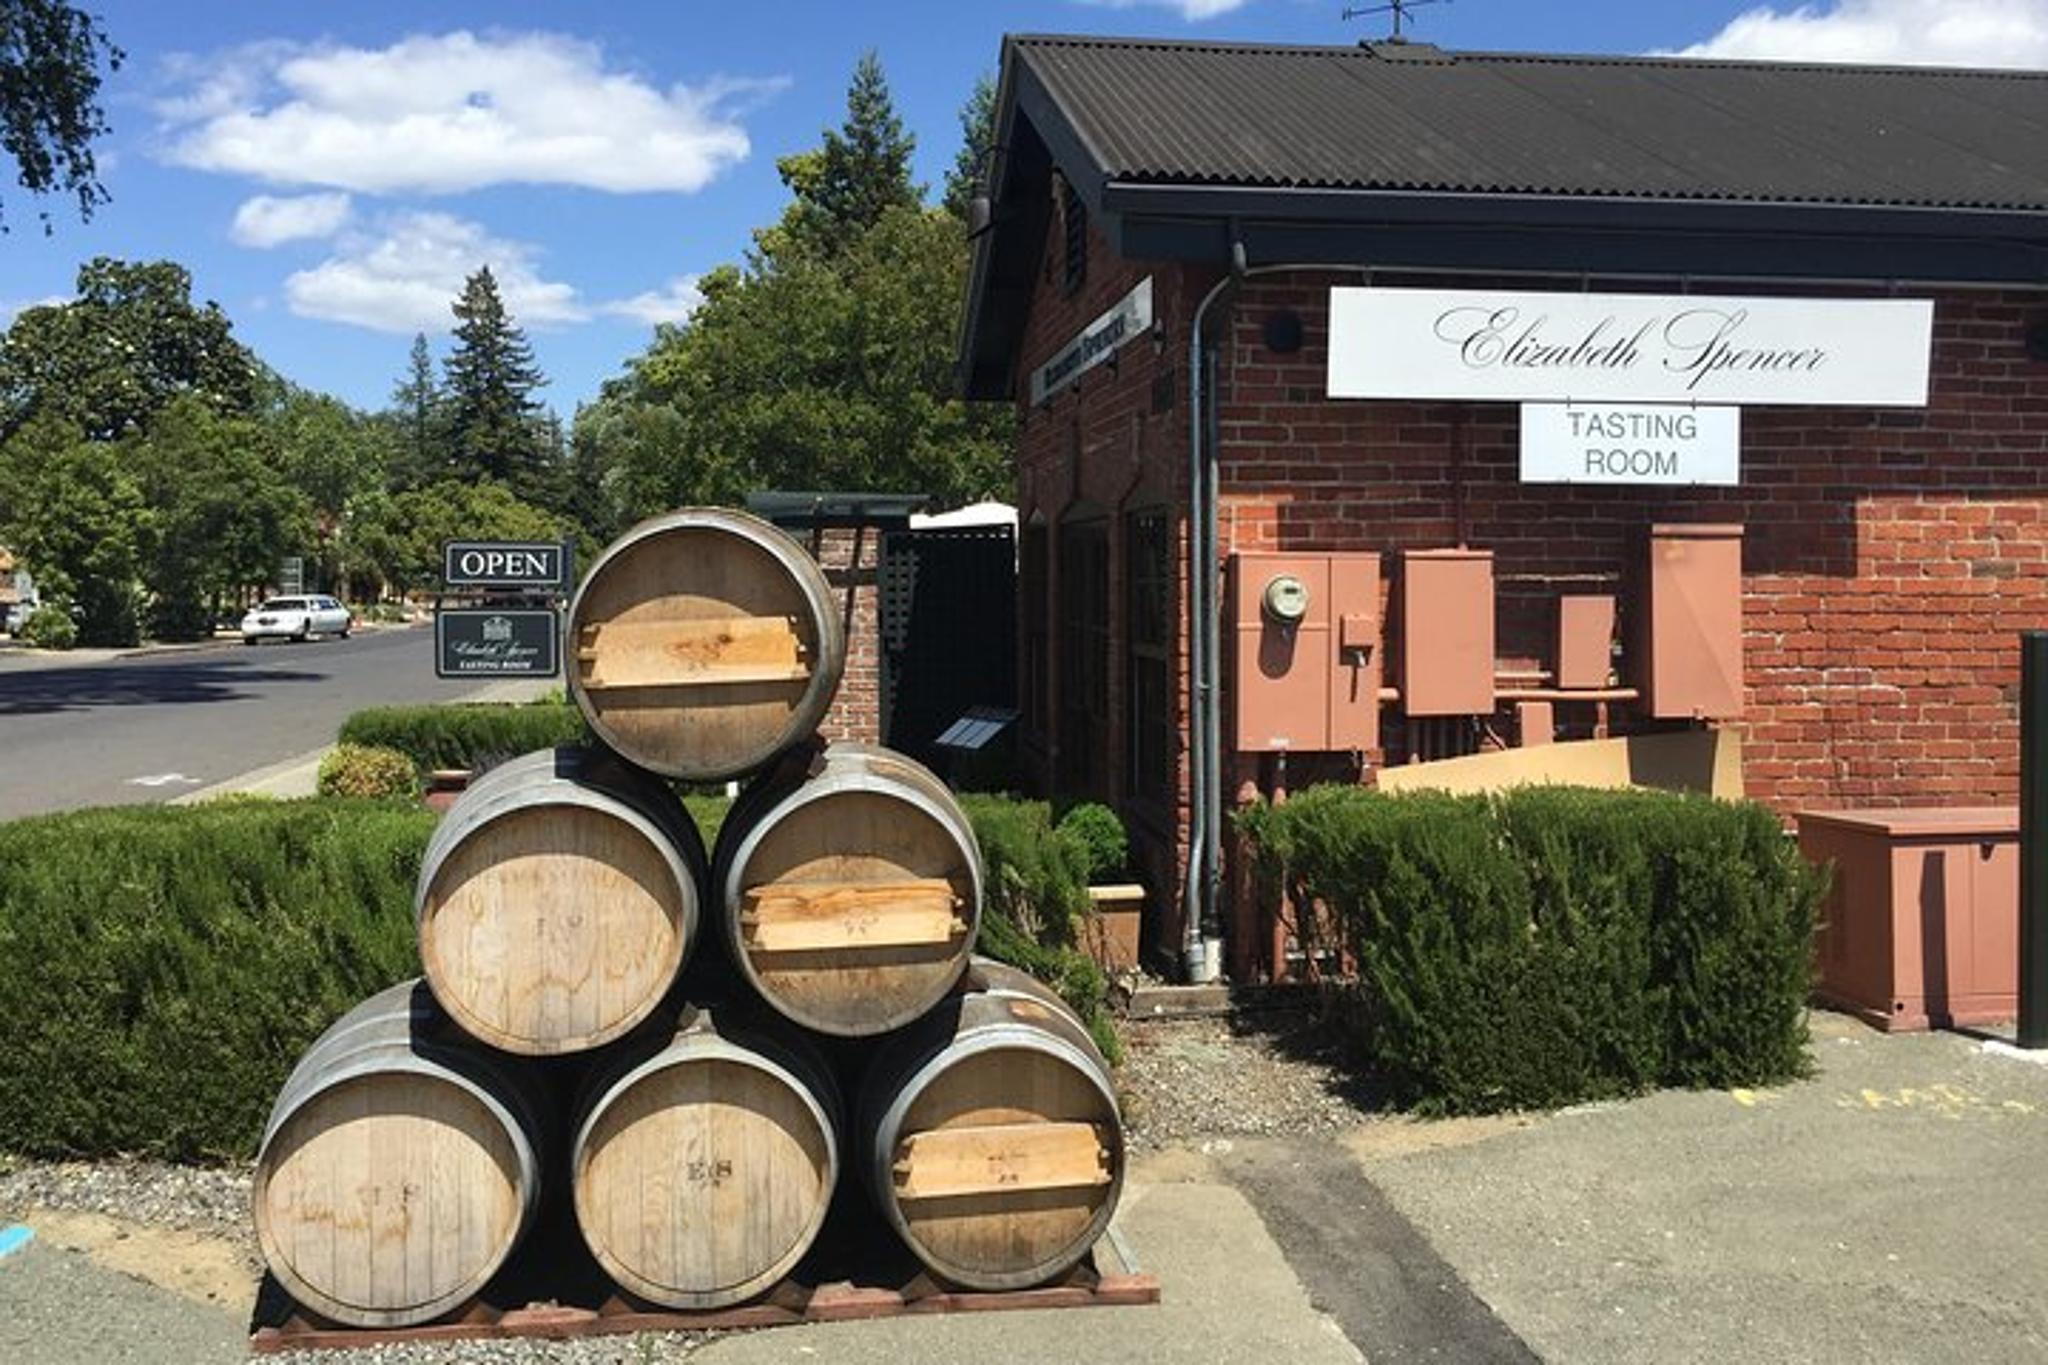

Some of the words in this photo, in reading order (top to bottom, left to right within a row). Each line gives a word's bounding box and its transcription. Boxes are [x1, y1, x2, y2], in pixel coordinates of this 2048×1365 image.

[1434, 306, 1660, 369] Elizabeth
[1663, 308, 1828, 390] Spencer
[1567, 412, 1697, 440] TASTING
[1586, 449, 1678, 477] ROOM
[460, 551, 548, 576] OPEN
